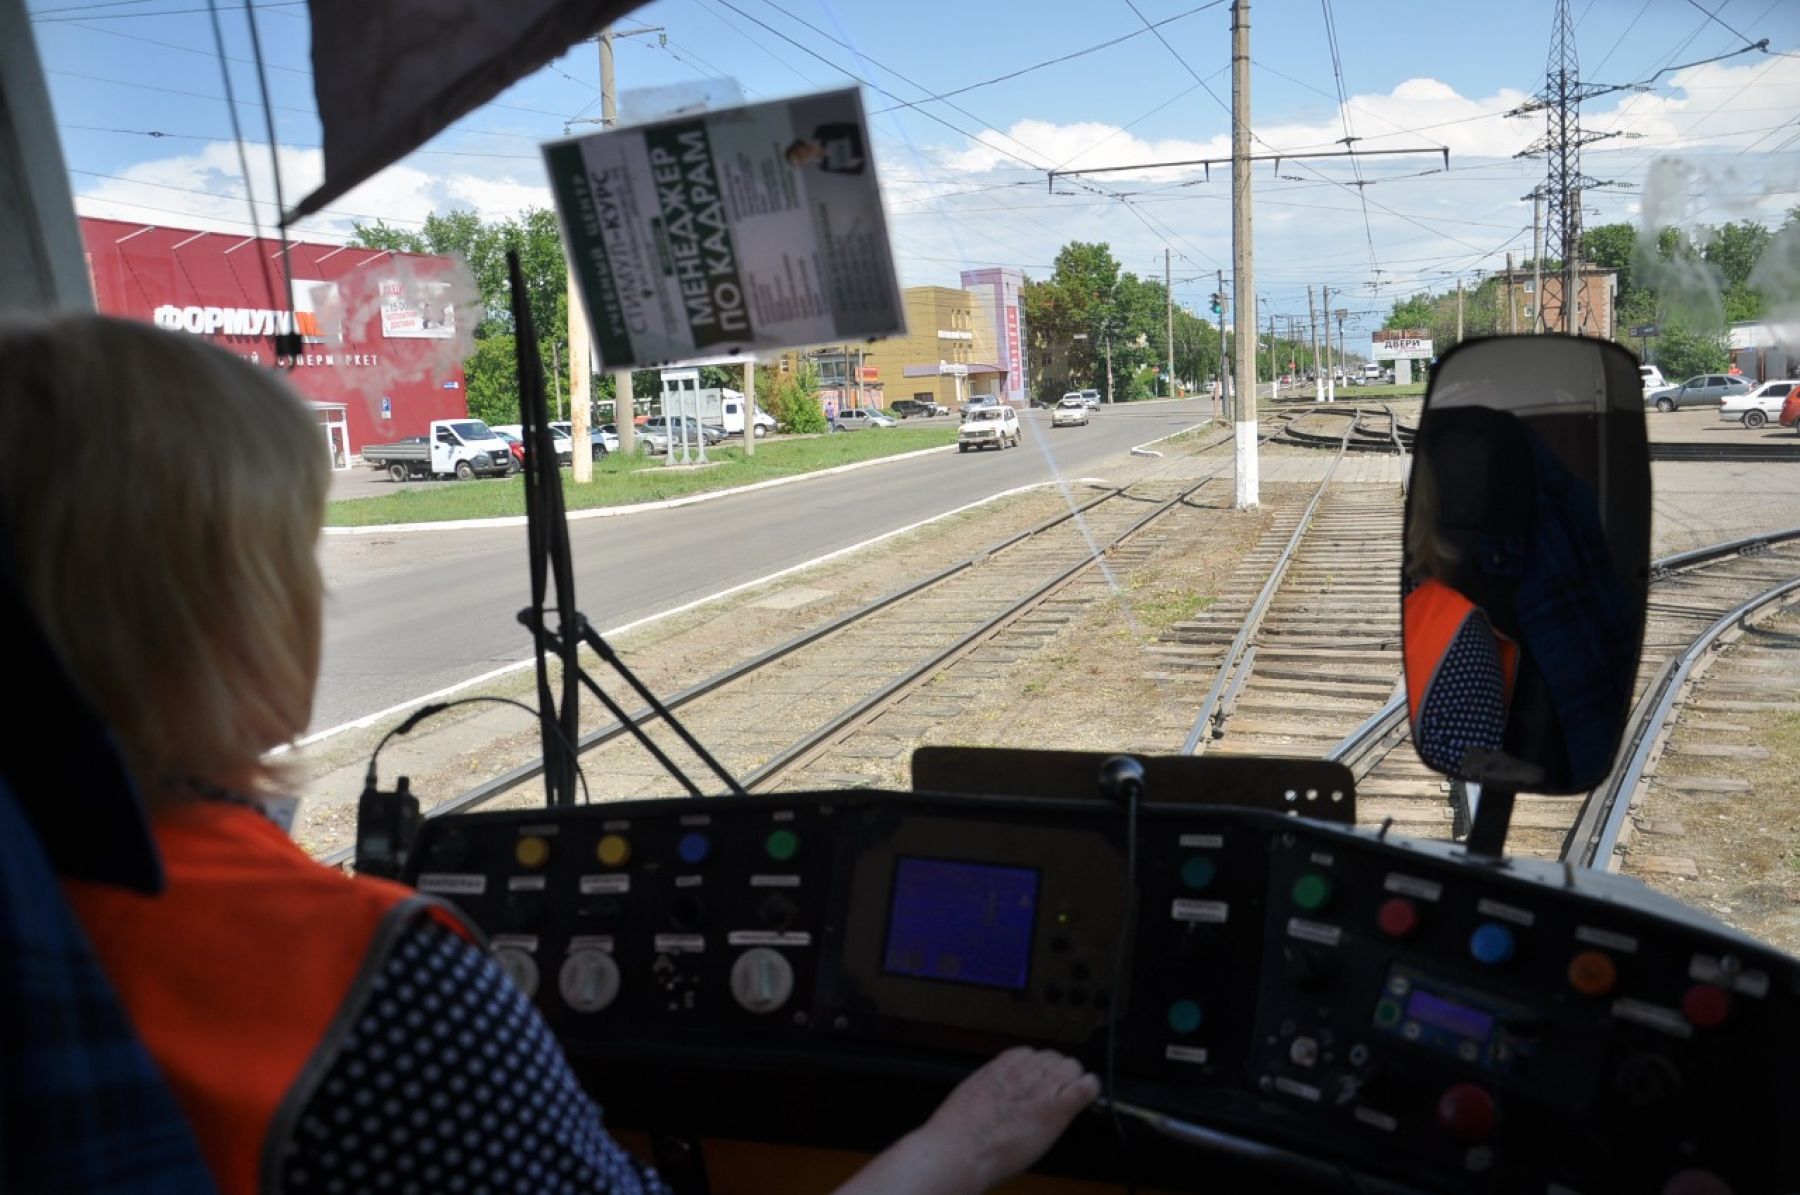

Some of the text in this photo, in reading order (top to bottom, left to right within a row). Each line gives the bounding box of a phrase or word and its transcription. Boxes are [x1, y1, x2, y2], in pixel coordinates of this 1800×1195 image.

[591, 169, 648, 335] СТИМУЛ-КУРС
[653, 146, 715, 326] МЕНЕДЖЕР
[678, 131, 747, 331] ПО КАДРАМ
[1384, 339, 1420, 349] ДВЕРИ
